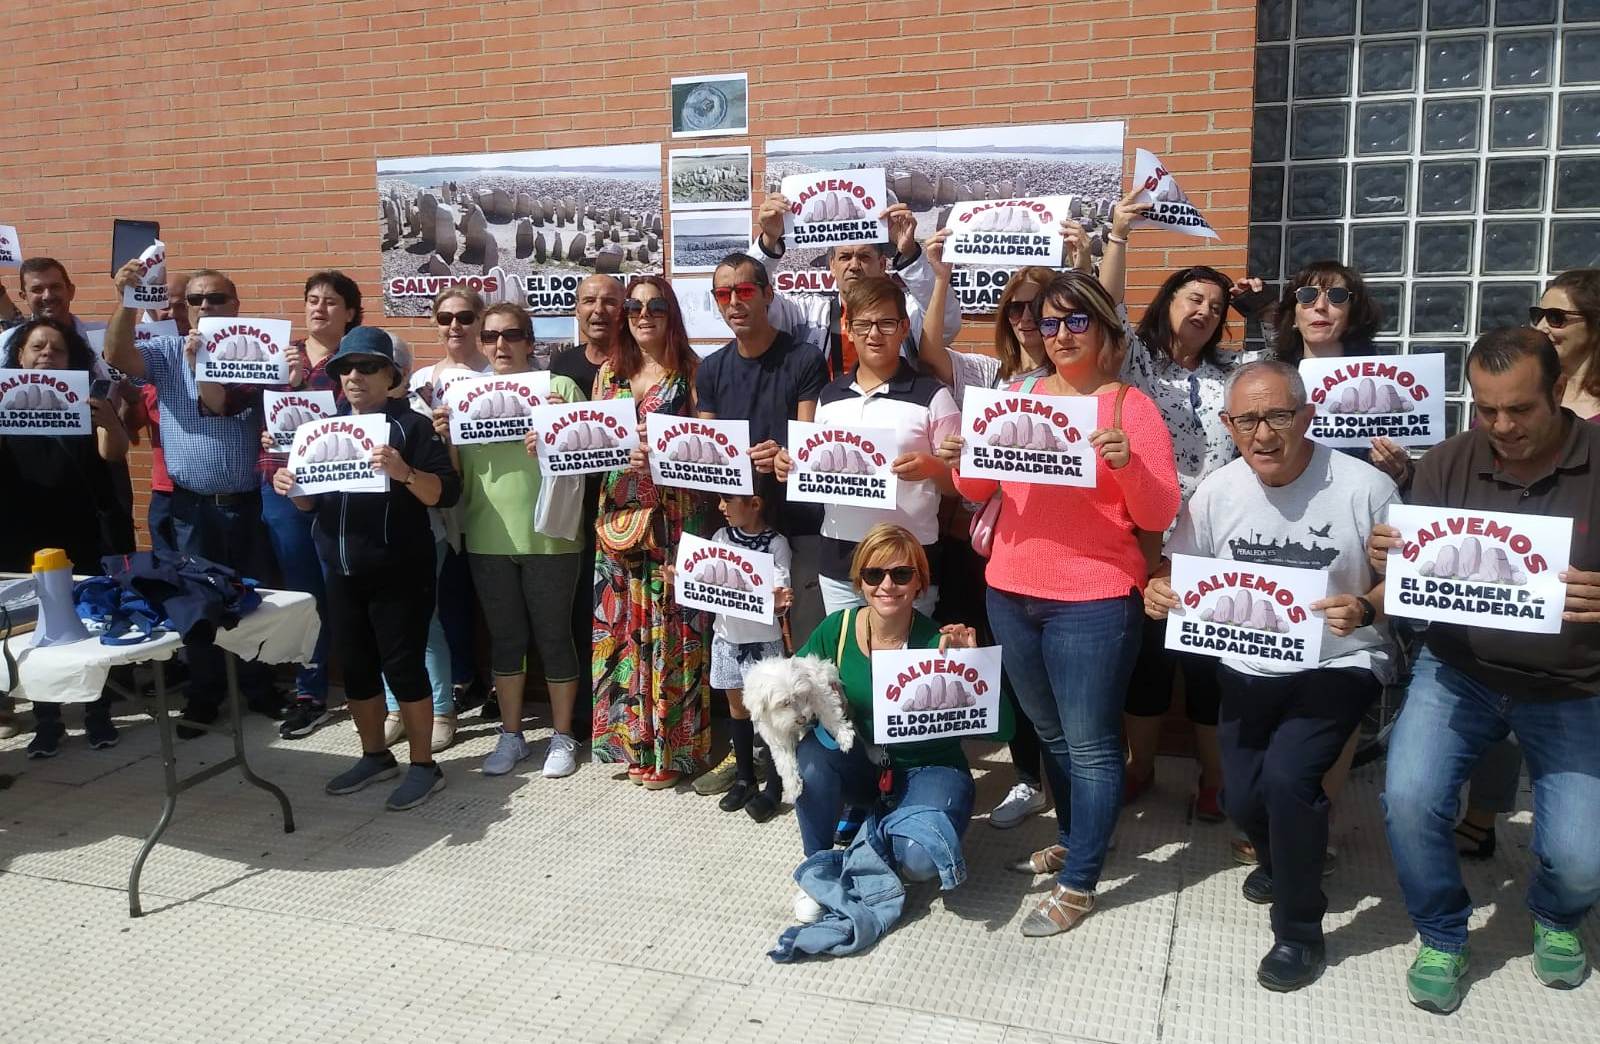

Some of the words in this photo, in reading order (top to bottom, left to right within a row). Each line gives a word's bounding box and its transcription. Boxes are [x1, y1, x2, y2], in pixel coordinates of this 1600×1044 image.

[792, 180, 876, 215] SALVEMOS
[958, 200, 1053, 224] SALVEMOS
[794, 226, 806, 235] EL
[809, 222, 859, 233] DOLMEN
[862, 221, 878, 230] DE
[973, 234, 1029, 245] DOLMEN
[1033, 235, 1051, 246] DE
[527, 277, 546, 291] EL
[206, 325, 279, 354] SALVEMOS
[205, 361, 218, 370] EL
[221, 362, 262, 371] DOLMEN
[265, 364, 279, 372] DE
[1311, 362, 1430, 405] SALVEMOS
[458, 381, 540, 413] SALVEMOS
[10, 411, 61, 420] DOLMEN
[64, 412, 80, 420] DE
[460, 422, 473, 431] EL
[476, 418, 525, 429] DOLMEN
[544, 409, 628, 446] SALVEMOS
[973, 398, 1081, 444] SALVEMOS
[1312, 416, 1330, 426] EL
[1335, 415, 1403, 427] DOLMEN
[1408, 414, 1430, 425] DE
[298, 421, 375, 457] SALVEMOS
[657, 422, 739, 458] SALVEMOS
[797, 430, 887, 467] SALVEMOS
[296, 466, 307, 475] EL
[310, 462, 357, 474] DOLMEN
[548, 455, 561, 463] EL
[564, 450, 613, 461] DOLMEN
[973, 447, 989, 458] EL
[993, 448, 1058, 465] DOLMEN
[1061, 455, 1082, 466] DE
[659, 462, 672, 470] EL
[675, 463, 722, 475] DOLMEN
[725, 468, 742, 477] DE
[799, 473, 813, 482] EL
[816, 474, 868, 487] DOLMEN
[871, 478, 887, 488] DE
[1402, 517, 1548, 574] SALVEMOS
[684, 547, 763, 587] SALVEMOS
[684, 581, 696, 591] EL
[699, 584, 746, 601] DOLMEN
[749, 594, 764, 605] DE
[1184, 572, 1307, 624] SALVEMOS
[1400, 577, 1420, 591] EL
[1425, 579, 1511, 601] DOLMEN
[1182, 621, 1200, 634] EL
[1205, 624, 1276, 647] DOLMEN
[1281, 636, 1305, 650] DE
[886, 659, 988, 702] SALVEMOS
[887, 715, 903, 726] EL
[907, 709, 966, 725] DOLMEN
[969, 708, 987, 719] DE
